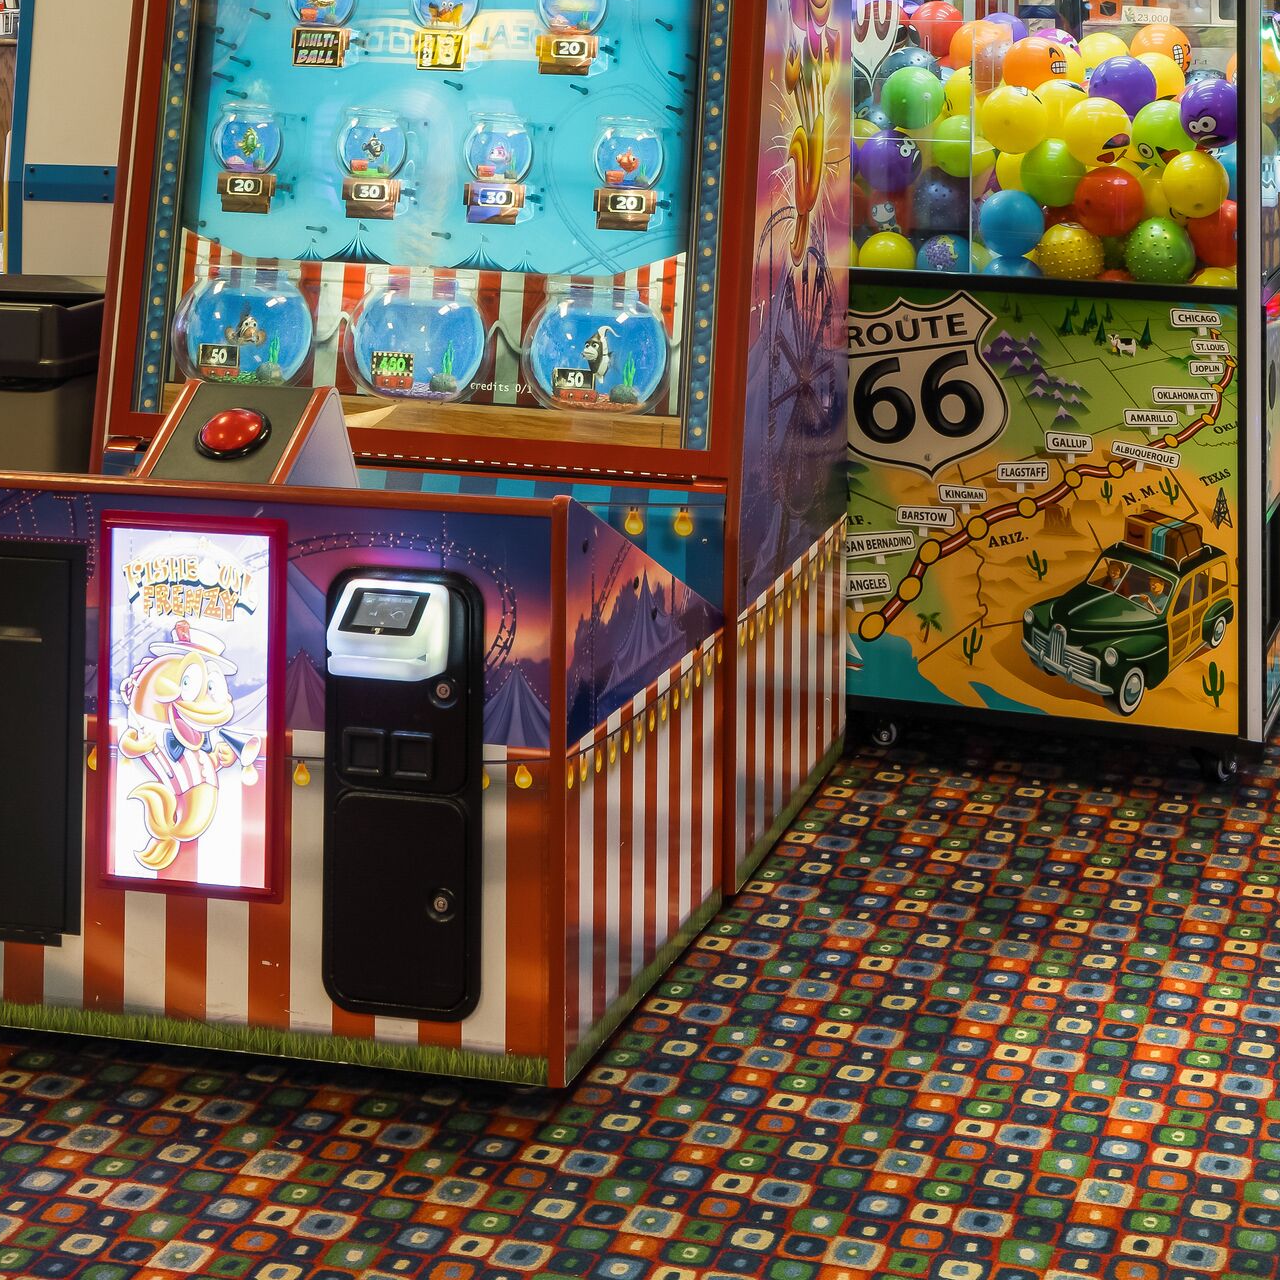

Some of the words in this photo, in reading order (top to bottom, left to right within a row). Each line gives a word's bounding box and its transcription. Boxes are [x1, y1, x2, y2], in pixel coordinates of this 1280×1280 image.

[1138, 13, 1169, 24] 23,000
[559, 42, 581, 55] 20
[296, 50, 335, 65] BALL
[234, 178, 255, 193] 20
[359, 184, 380, 199] 30
[486, 189, 507, 205] 30
[616, 196, 638, 211] 20
[1178, 313, 1218, 324] CHICAGO
[849, 312, 968, 350] ROUTE
[210, 347, 228, 366] 50
[1194, 363, 1221, 373] JOPLIN
[566, 371, 584, 388] 50
[470, 381, 511, 394] credits
[853, 349, 986, 445] 66
[1156, 391, 1196, 402] OKLAHOMA
[1198, 391, 1216, 401] CITY
[1129, 412, 1174, 424] AMARILLO
[1051, 436, 1088, 451] GALLUP
[1114, 444, 1176, 466] ALBUQUERQUE
[1000, 466, 1047, 481] FLAGSTAFF
[944, 488, 985, 502] KINGMAN
[901, 509, 948, 523] BARSTOW
[847, 539, 866, 553] SAN
[867, 534, 912, 552] BERNADINO
[849, 576, 888, 593] ANGELES
[143, 583, 239, 622] FRENZY
